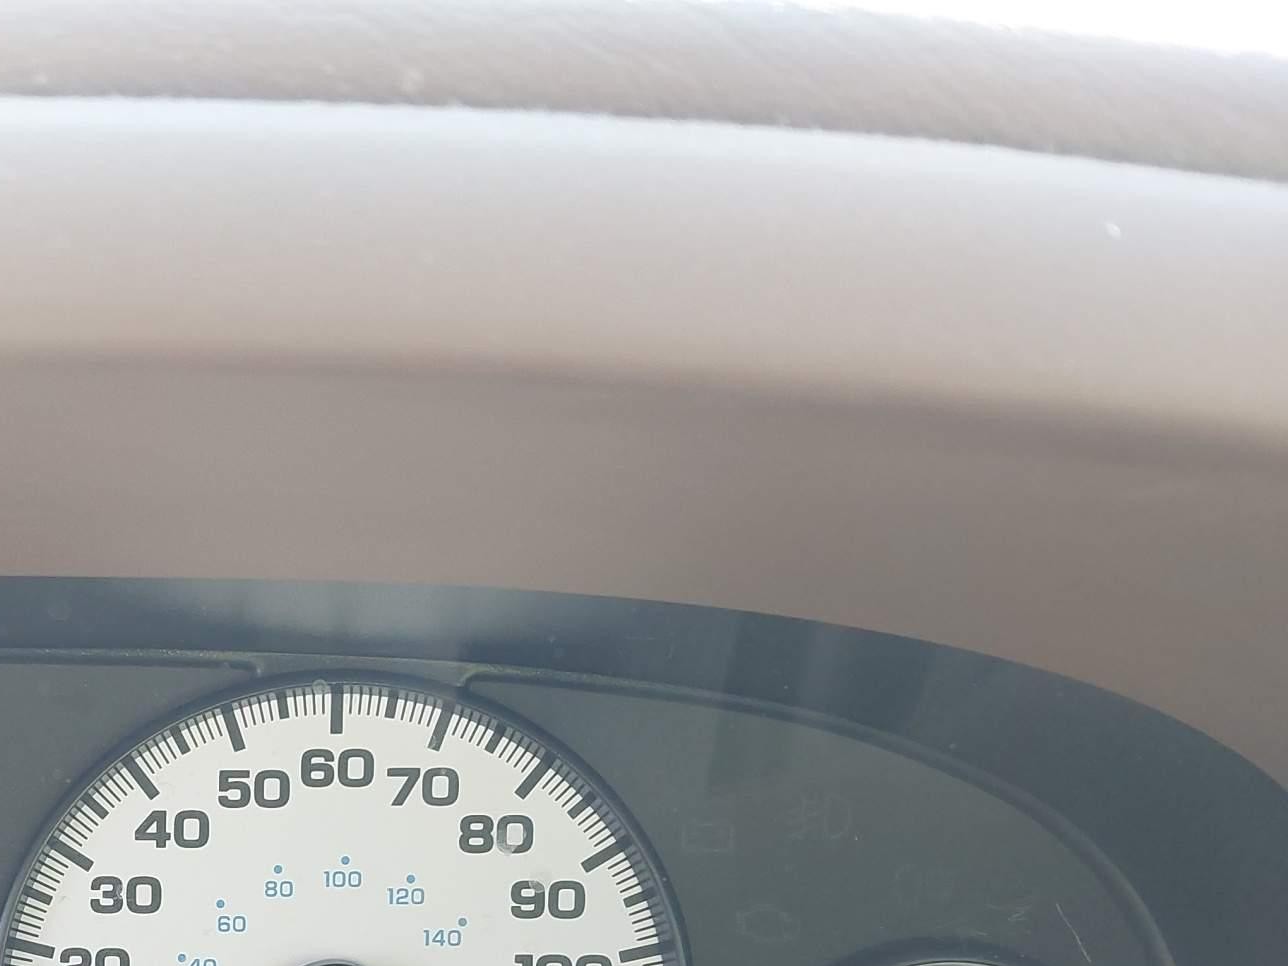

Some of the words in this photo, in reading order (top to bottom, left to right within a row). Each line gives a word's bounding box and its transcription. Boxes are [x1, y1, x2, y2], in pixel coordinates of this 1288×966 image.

[300, 748, 374, 788] 60
[386, 767, 459, 807] 70
[218, 770, 291, 809] 50
[134, 810, 210, 849] 40
[458, 814, 534, 854] 80
[89, 876, 162, 915] 30
[264, 880, 294, 899] 80
[323, 870, 362, 889] 100
[386, 887, 424, 906] 120
[510, 880, 585, 919] 90
[217, 915, 247, 933] 60
[423, 929, 462, 947] 140
